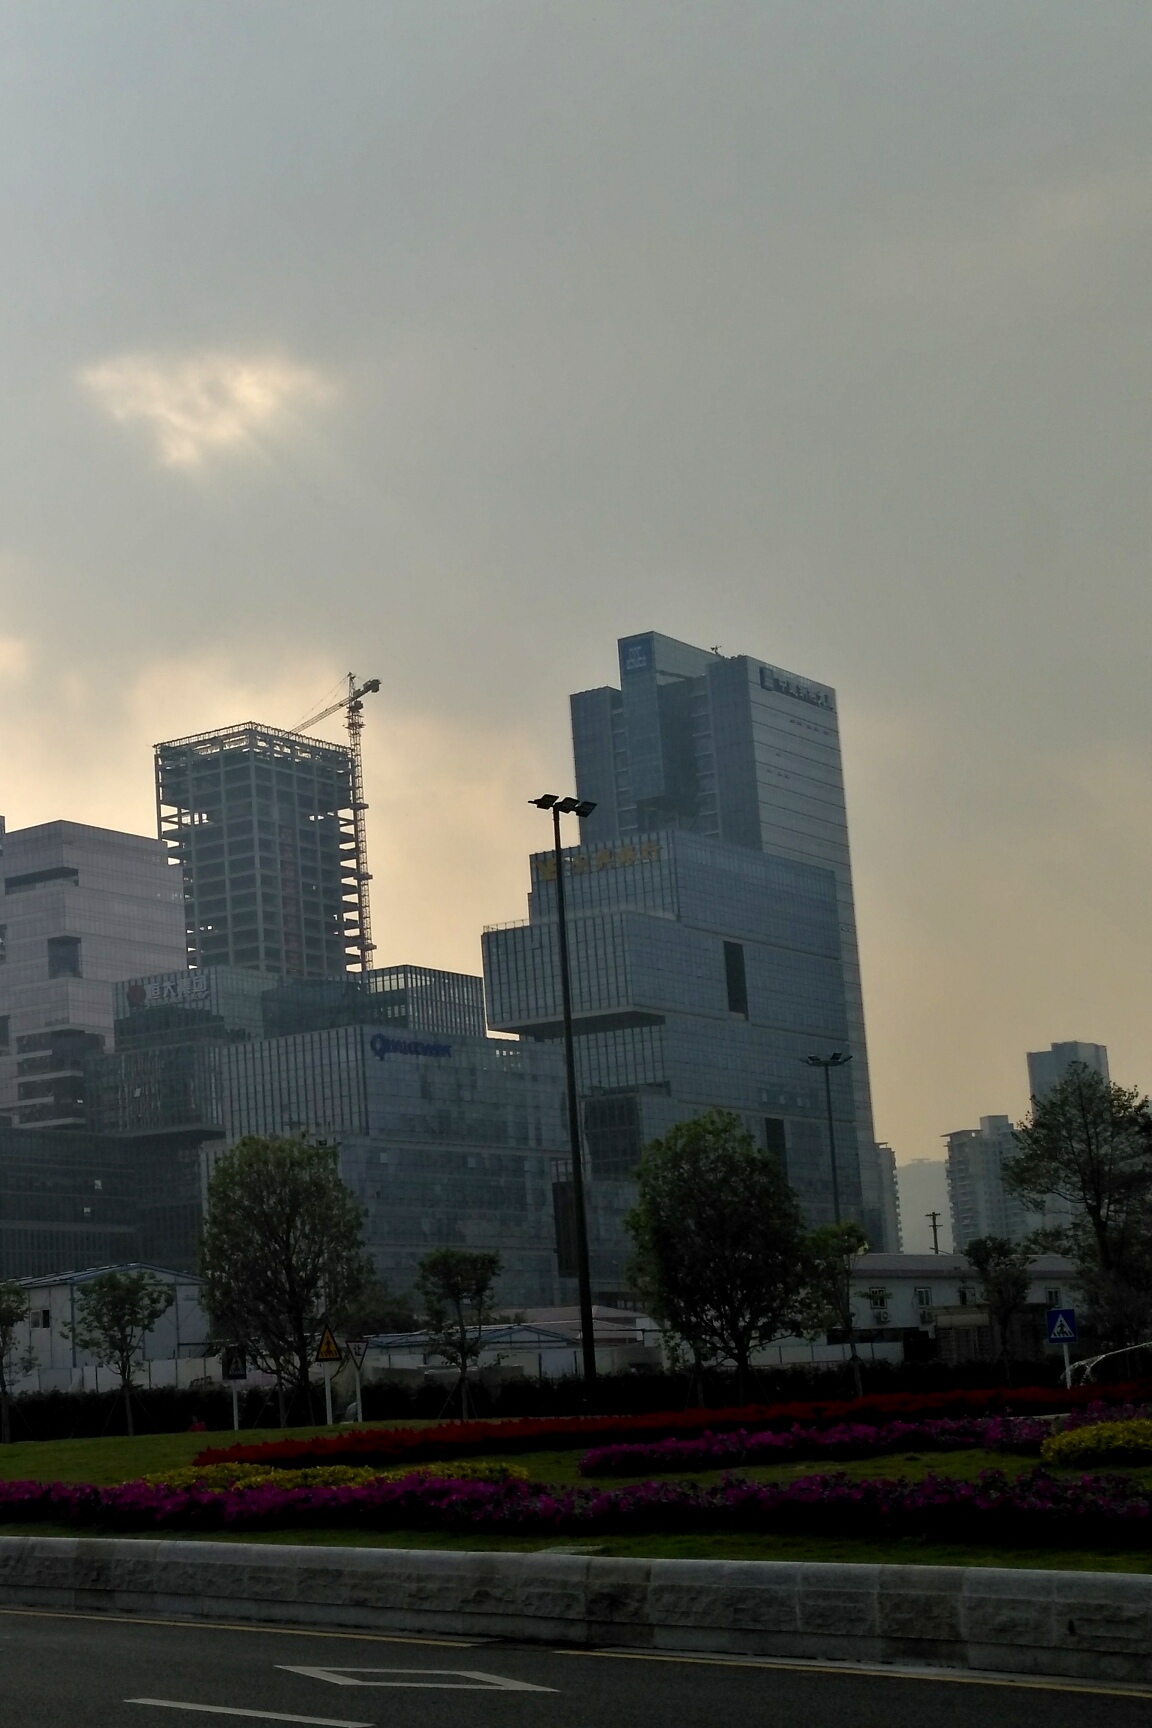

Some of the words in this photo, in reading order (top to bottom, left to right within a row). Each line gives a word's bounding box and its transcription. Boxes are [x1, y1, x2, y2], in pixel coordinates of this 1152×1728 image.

[145, 974, 208, 999] 恒大集团
[353, 1344, 362, 1356] 让
